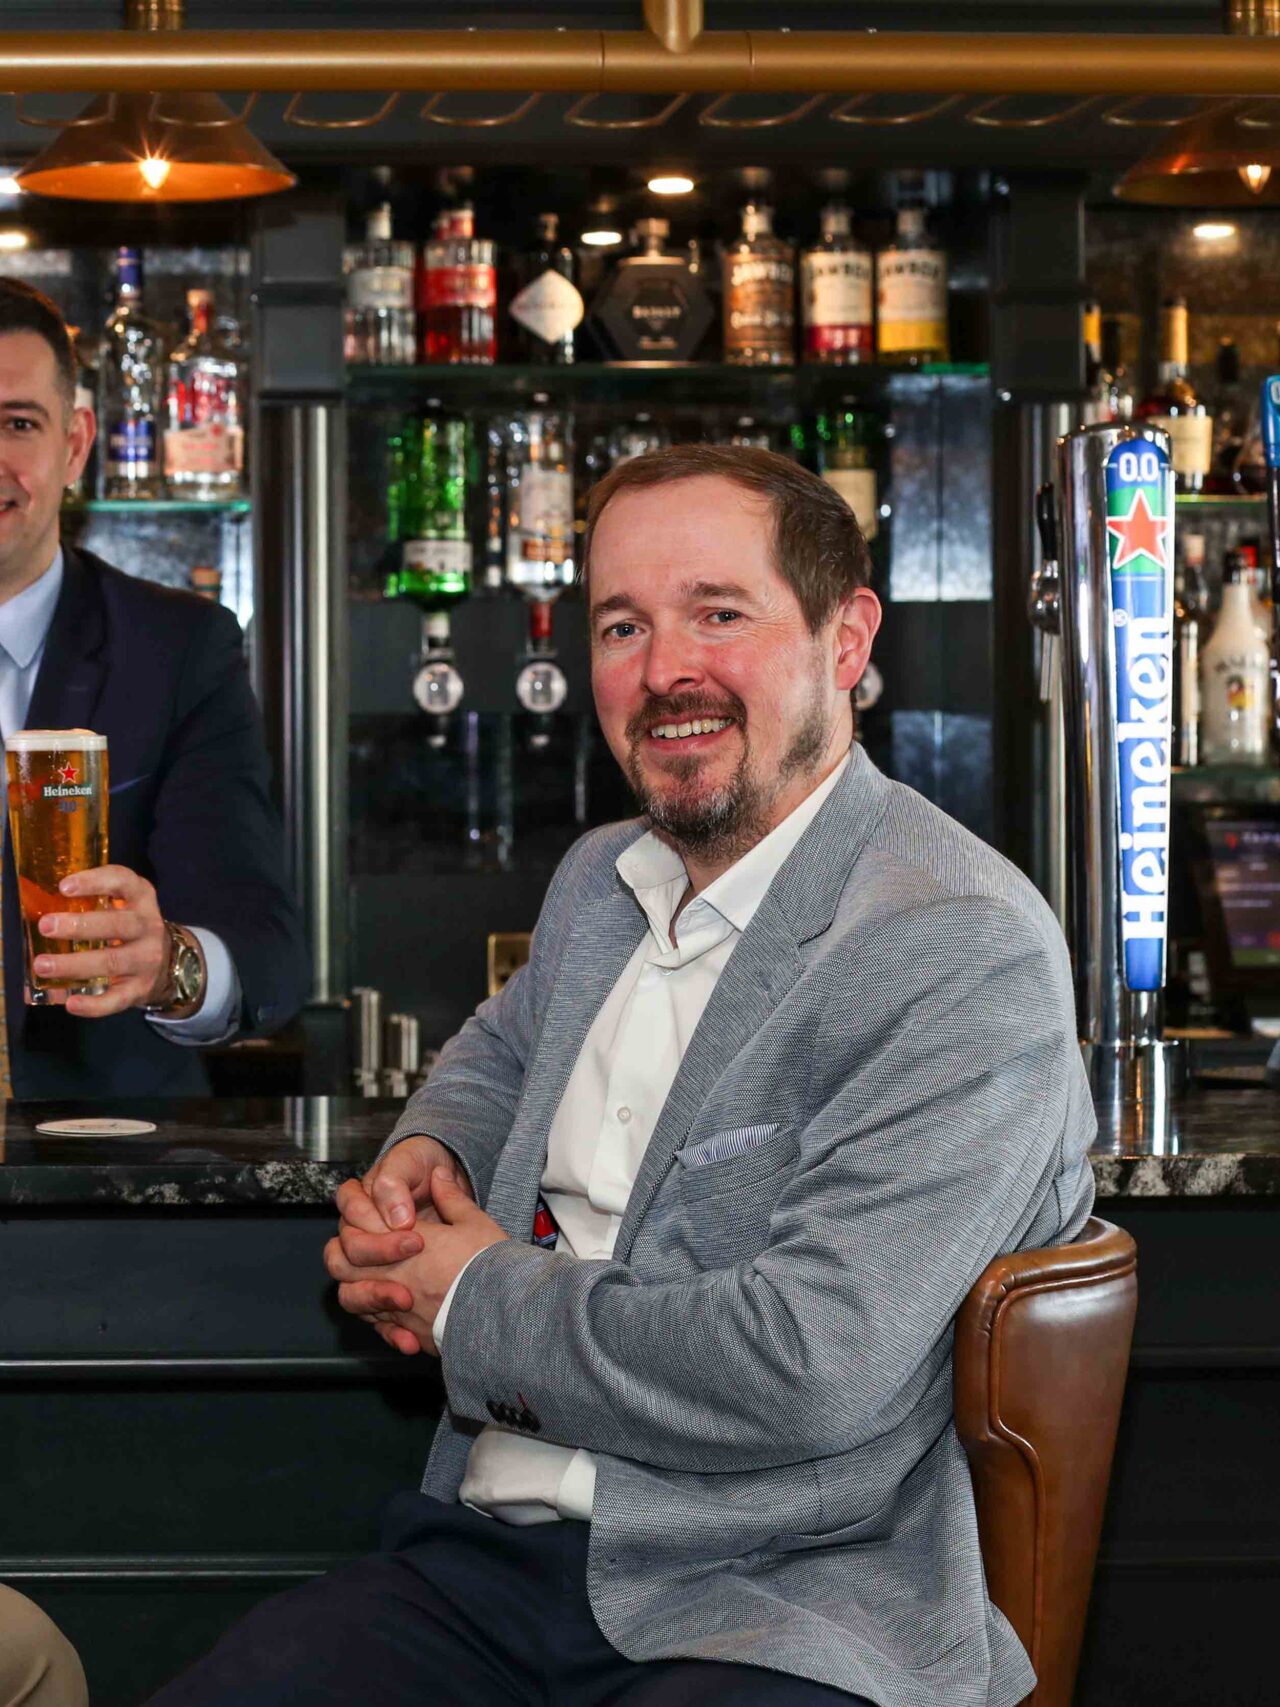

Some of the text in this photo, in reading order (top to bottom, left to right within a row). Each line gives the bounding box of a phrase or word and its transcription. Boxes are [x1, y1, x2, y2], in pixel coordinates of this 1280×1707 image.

[1119, 452, 1159, 482] 0.0
[43, 785, 92, 797] Heineken
[1117, 616, 1170, 941] Heineken
